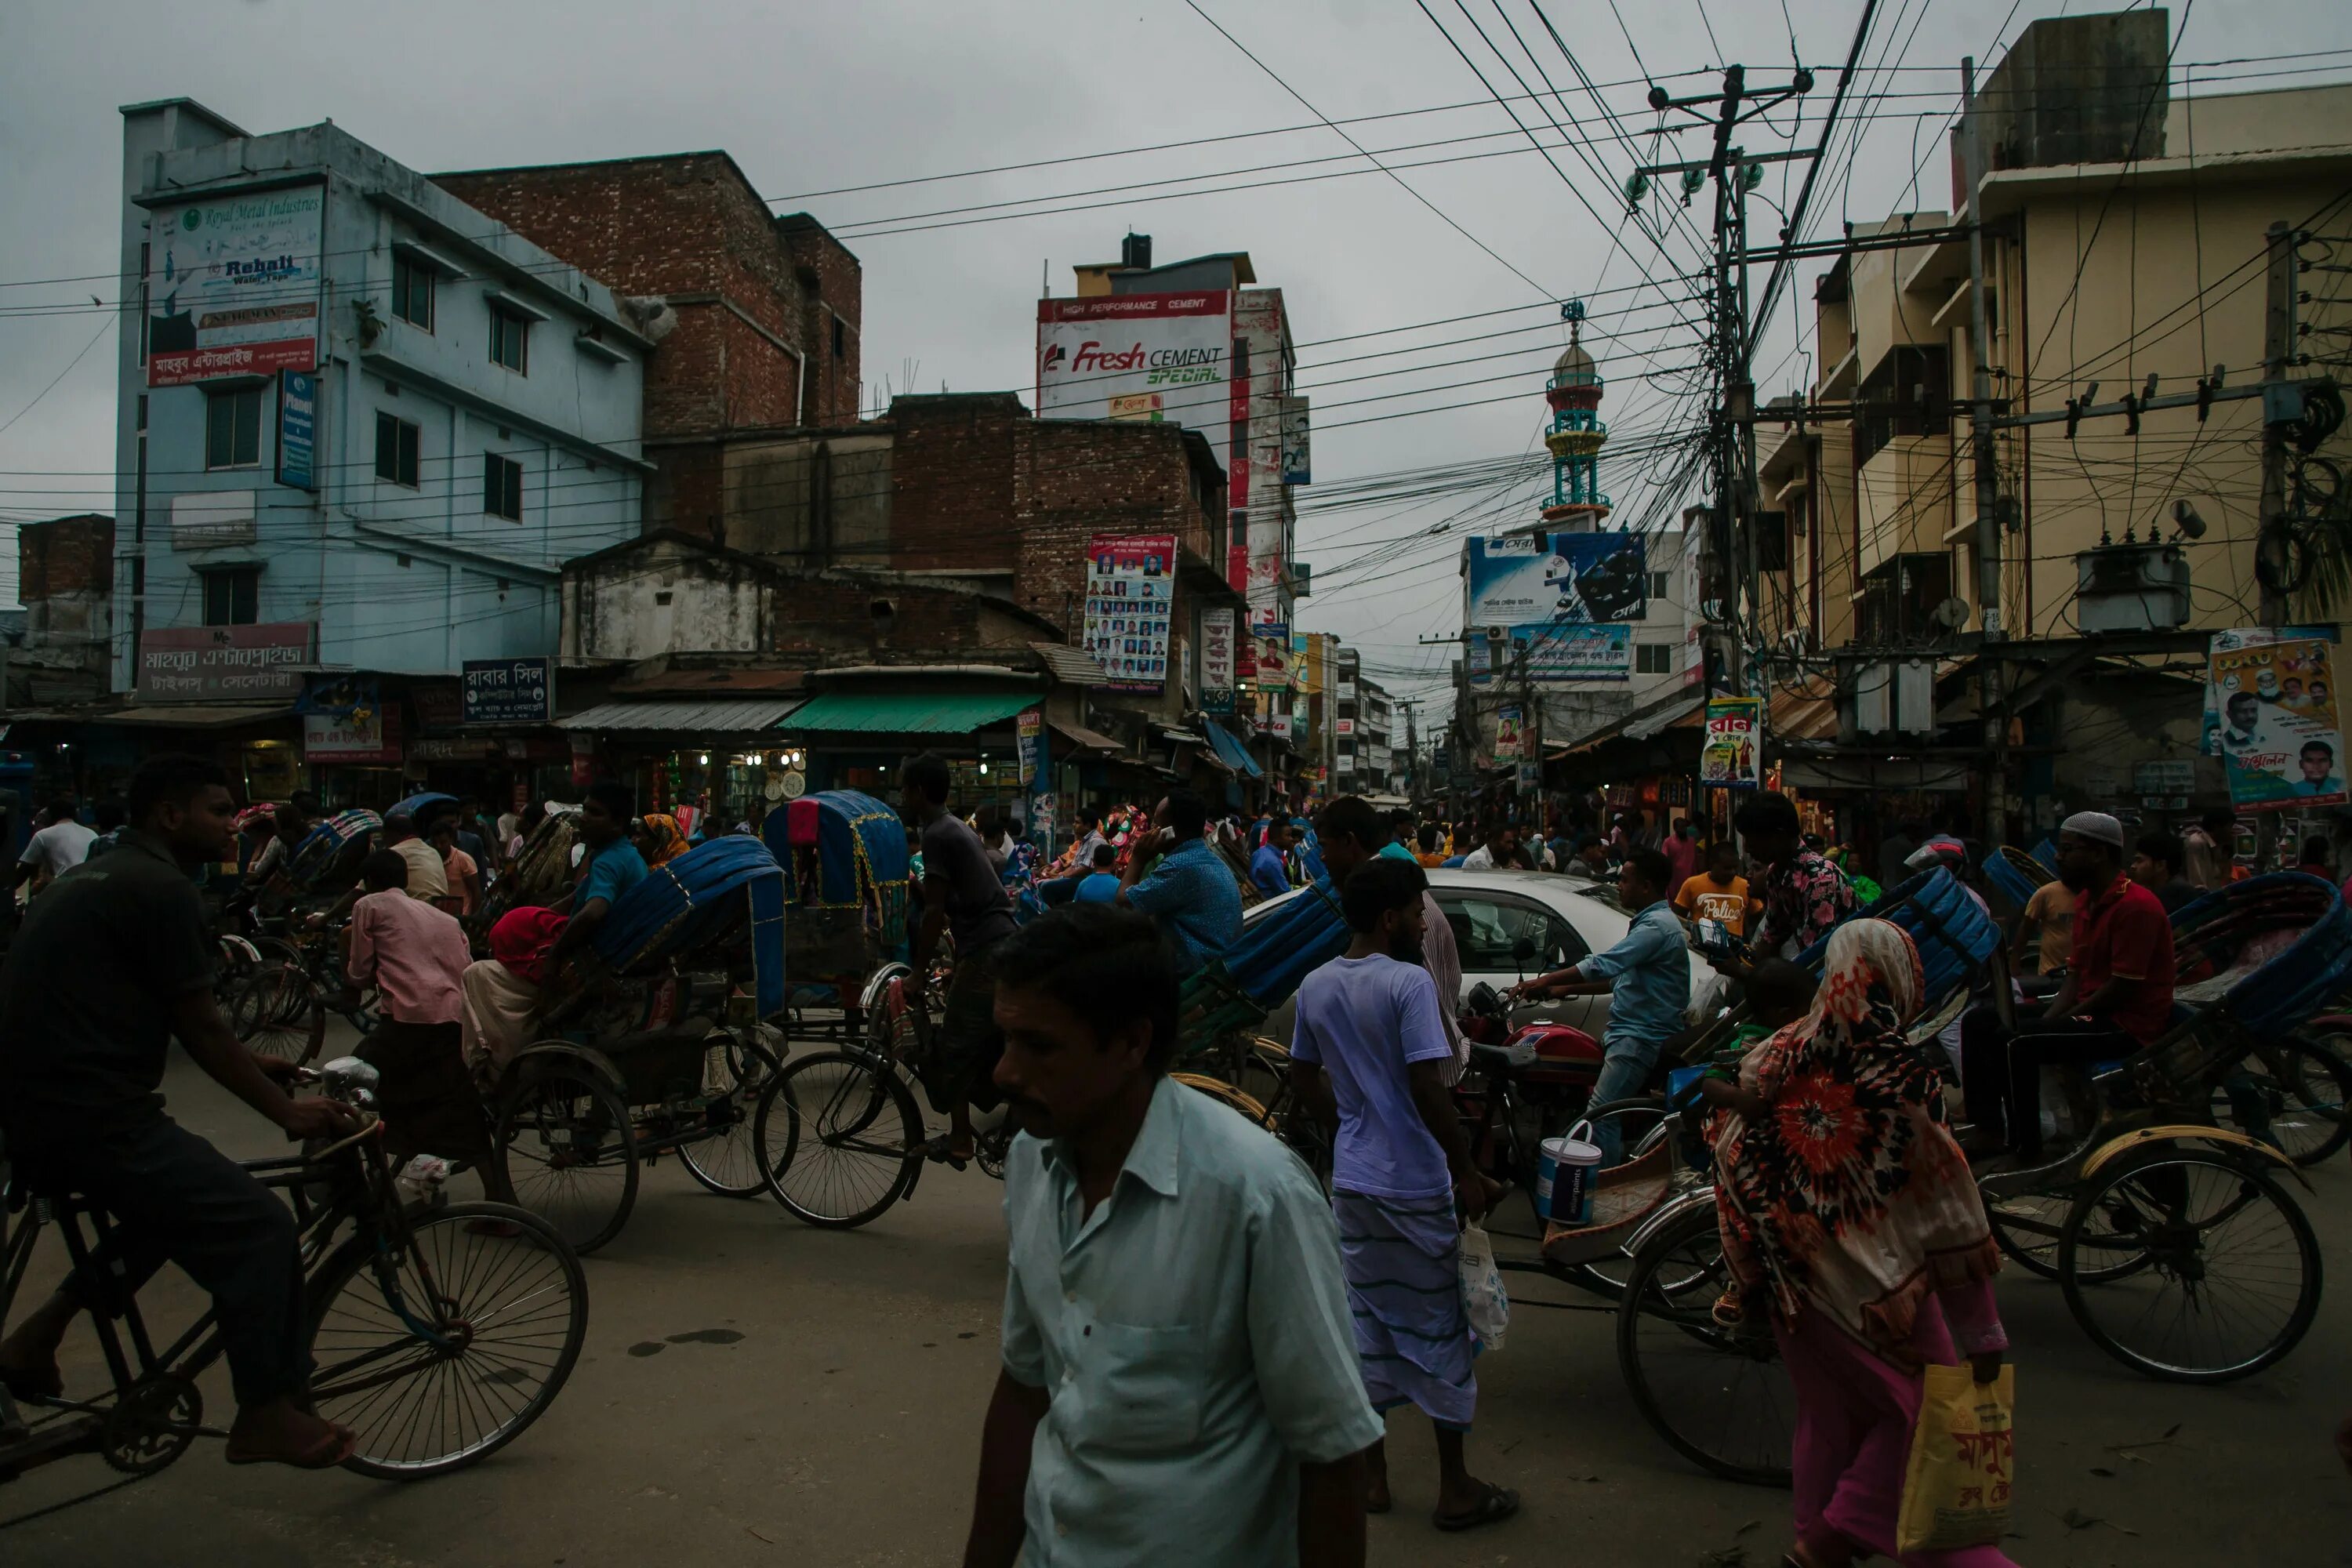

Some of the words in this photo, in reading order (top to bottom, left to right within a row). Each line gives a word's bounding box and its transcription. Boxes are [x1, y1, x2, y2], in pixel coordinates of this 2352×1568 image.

[205, 203, 232, 229] Royal
[235, 199, 267, 220] Metal
[269, 196, 319, 217] Industries
[234, 275, 260, 285] Water
[266, 274, 289, 283] Taps
[1062, 305, 1084, 314] HIGH
[1091, 300, 1158, 312] PERFORMANCE
[1167, 299, 1207, 309] CEMENT
[155, 357, 189, 374] মাহবুব
[193, 348, 254, 369] এন্টারপ্রাইজ
[1072, 341, 1145, 372] Fresh
[1149, 347, 1224, 366] CEMENT
[1147, 367, 1222, 384] SPECIAL
[146, 651, 197, 671] মাহবুব
[203, 643, 303, 668] এন্টারপ্রাইজ
[465, 667, 508, 687] রাবার
[514, 662, 544, 684] সিল
[1706, 712, 1754, 732] রনি
[1704, 898, 1741, 920] Police
